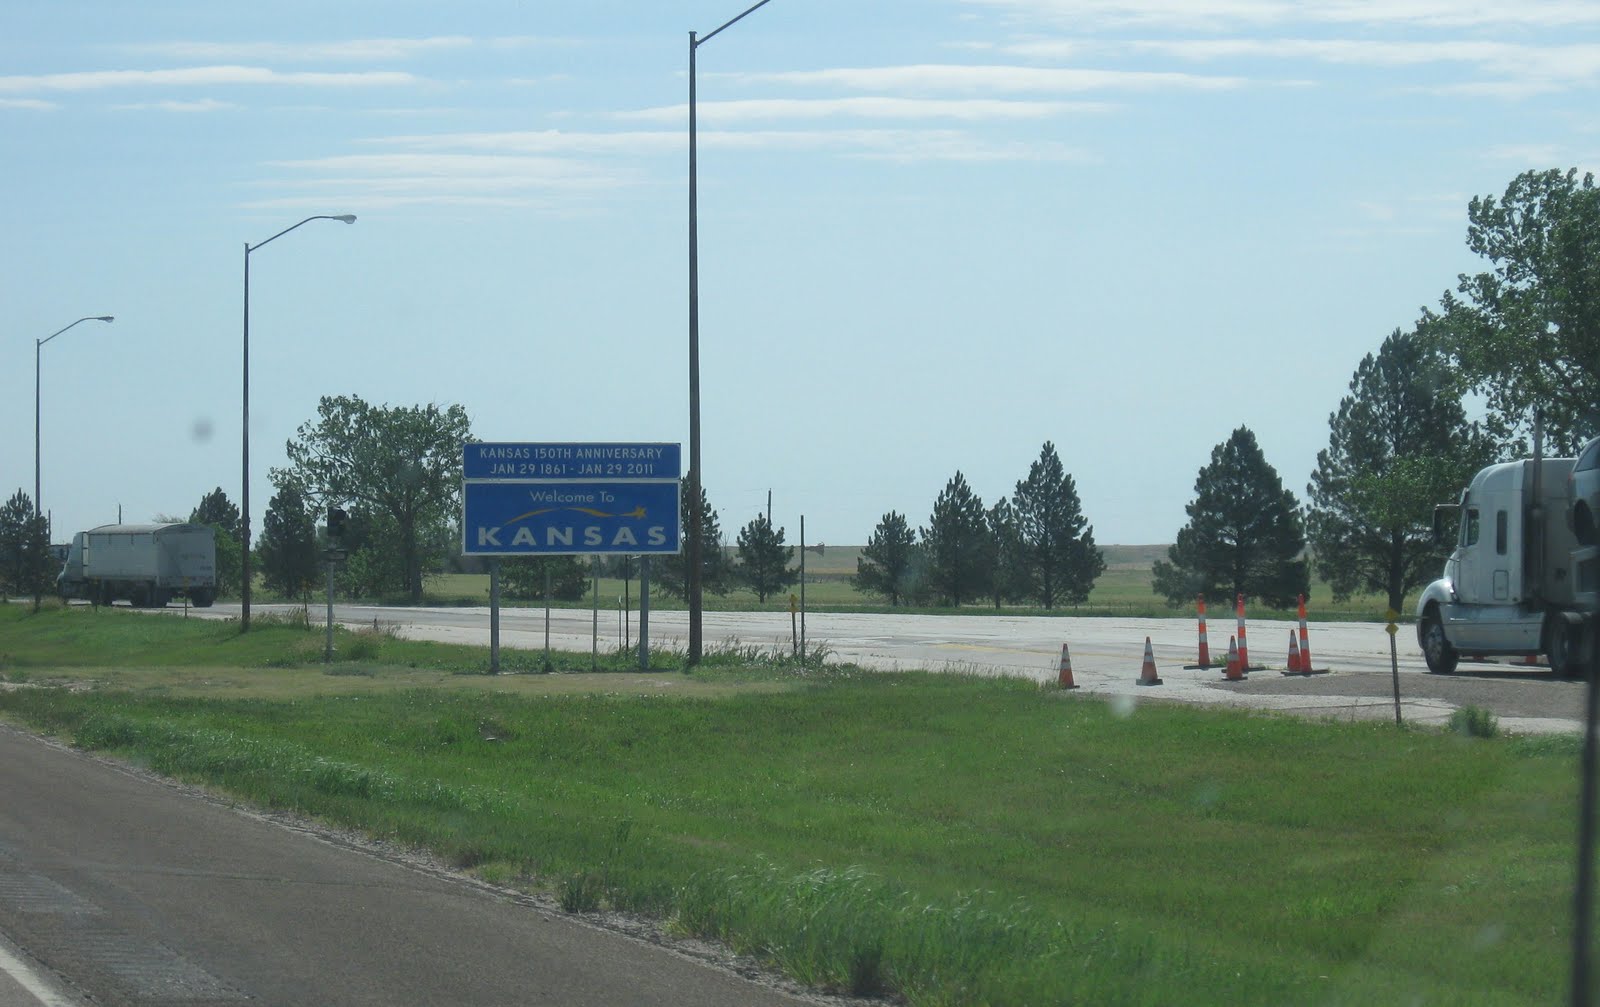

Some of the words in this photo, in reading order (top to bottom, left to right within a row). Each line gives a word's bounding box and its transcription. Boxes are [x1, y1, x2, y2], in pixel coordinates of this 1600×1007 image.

[480, 448, 530, 458] KANSAS
[535, 448, 571, 458] 150TH
[576, 448, 663, 458] ANNIVERSARY
[489, 464, 515, 474] JAN
[519, 464, 535, 474] 29
[540, 464, 566, 474] 1861
[578, 464, 602, 474] JAN
[607, 464, 622, 474] 29
[627, 464, 653, 474] 2011
[530, 490, 595, 503] Welcome
[600, 491, 615, 503] To
[479, 526, 665, 545] KANSAS
